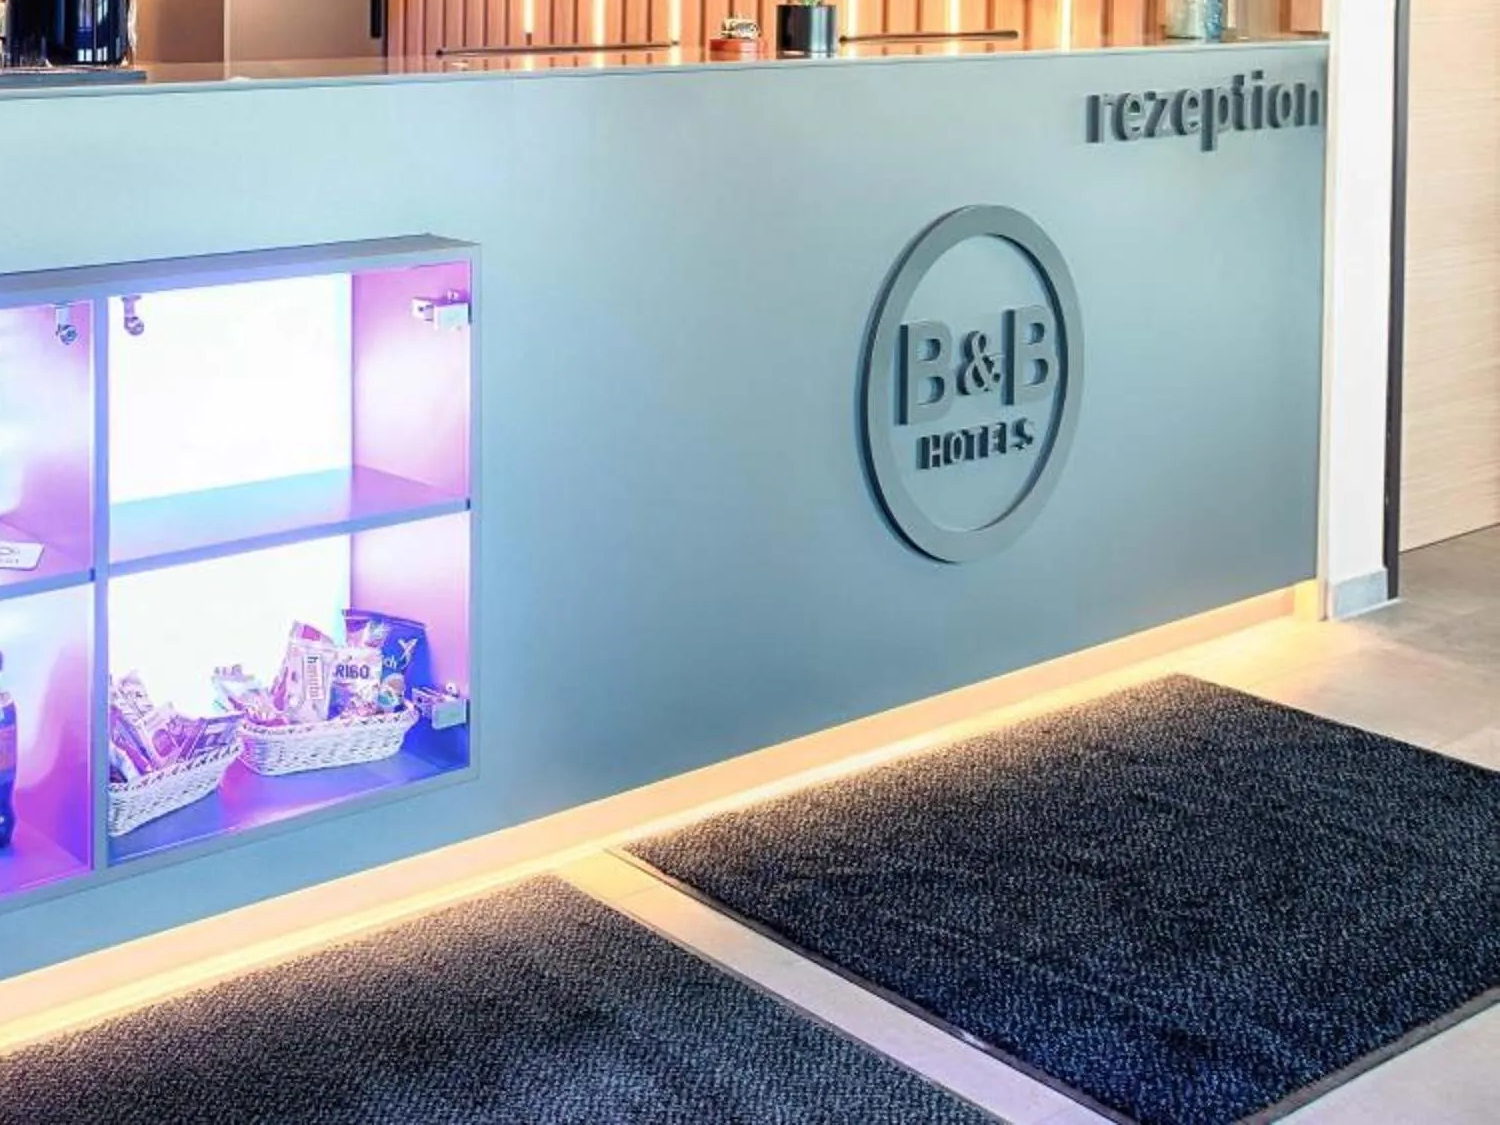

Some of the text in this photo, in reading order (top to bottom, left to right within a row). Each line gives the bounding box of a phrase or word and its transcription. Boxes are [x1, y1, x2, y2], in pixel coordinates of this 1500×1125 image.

[1085, 69, 1322, 152] rezeption
[894, 304, 1059, 427] B&B
[915, 417, 1036, 470] HOTELS
[334, 664, 371, 680] RIBO
